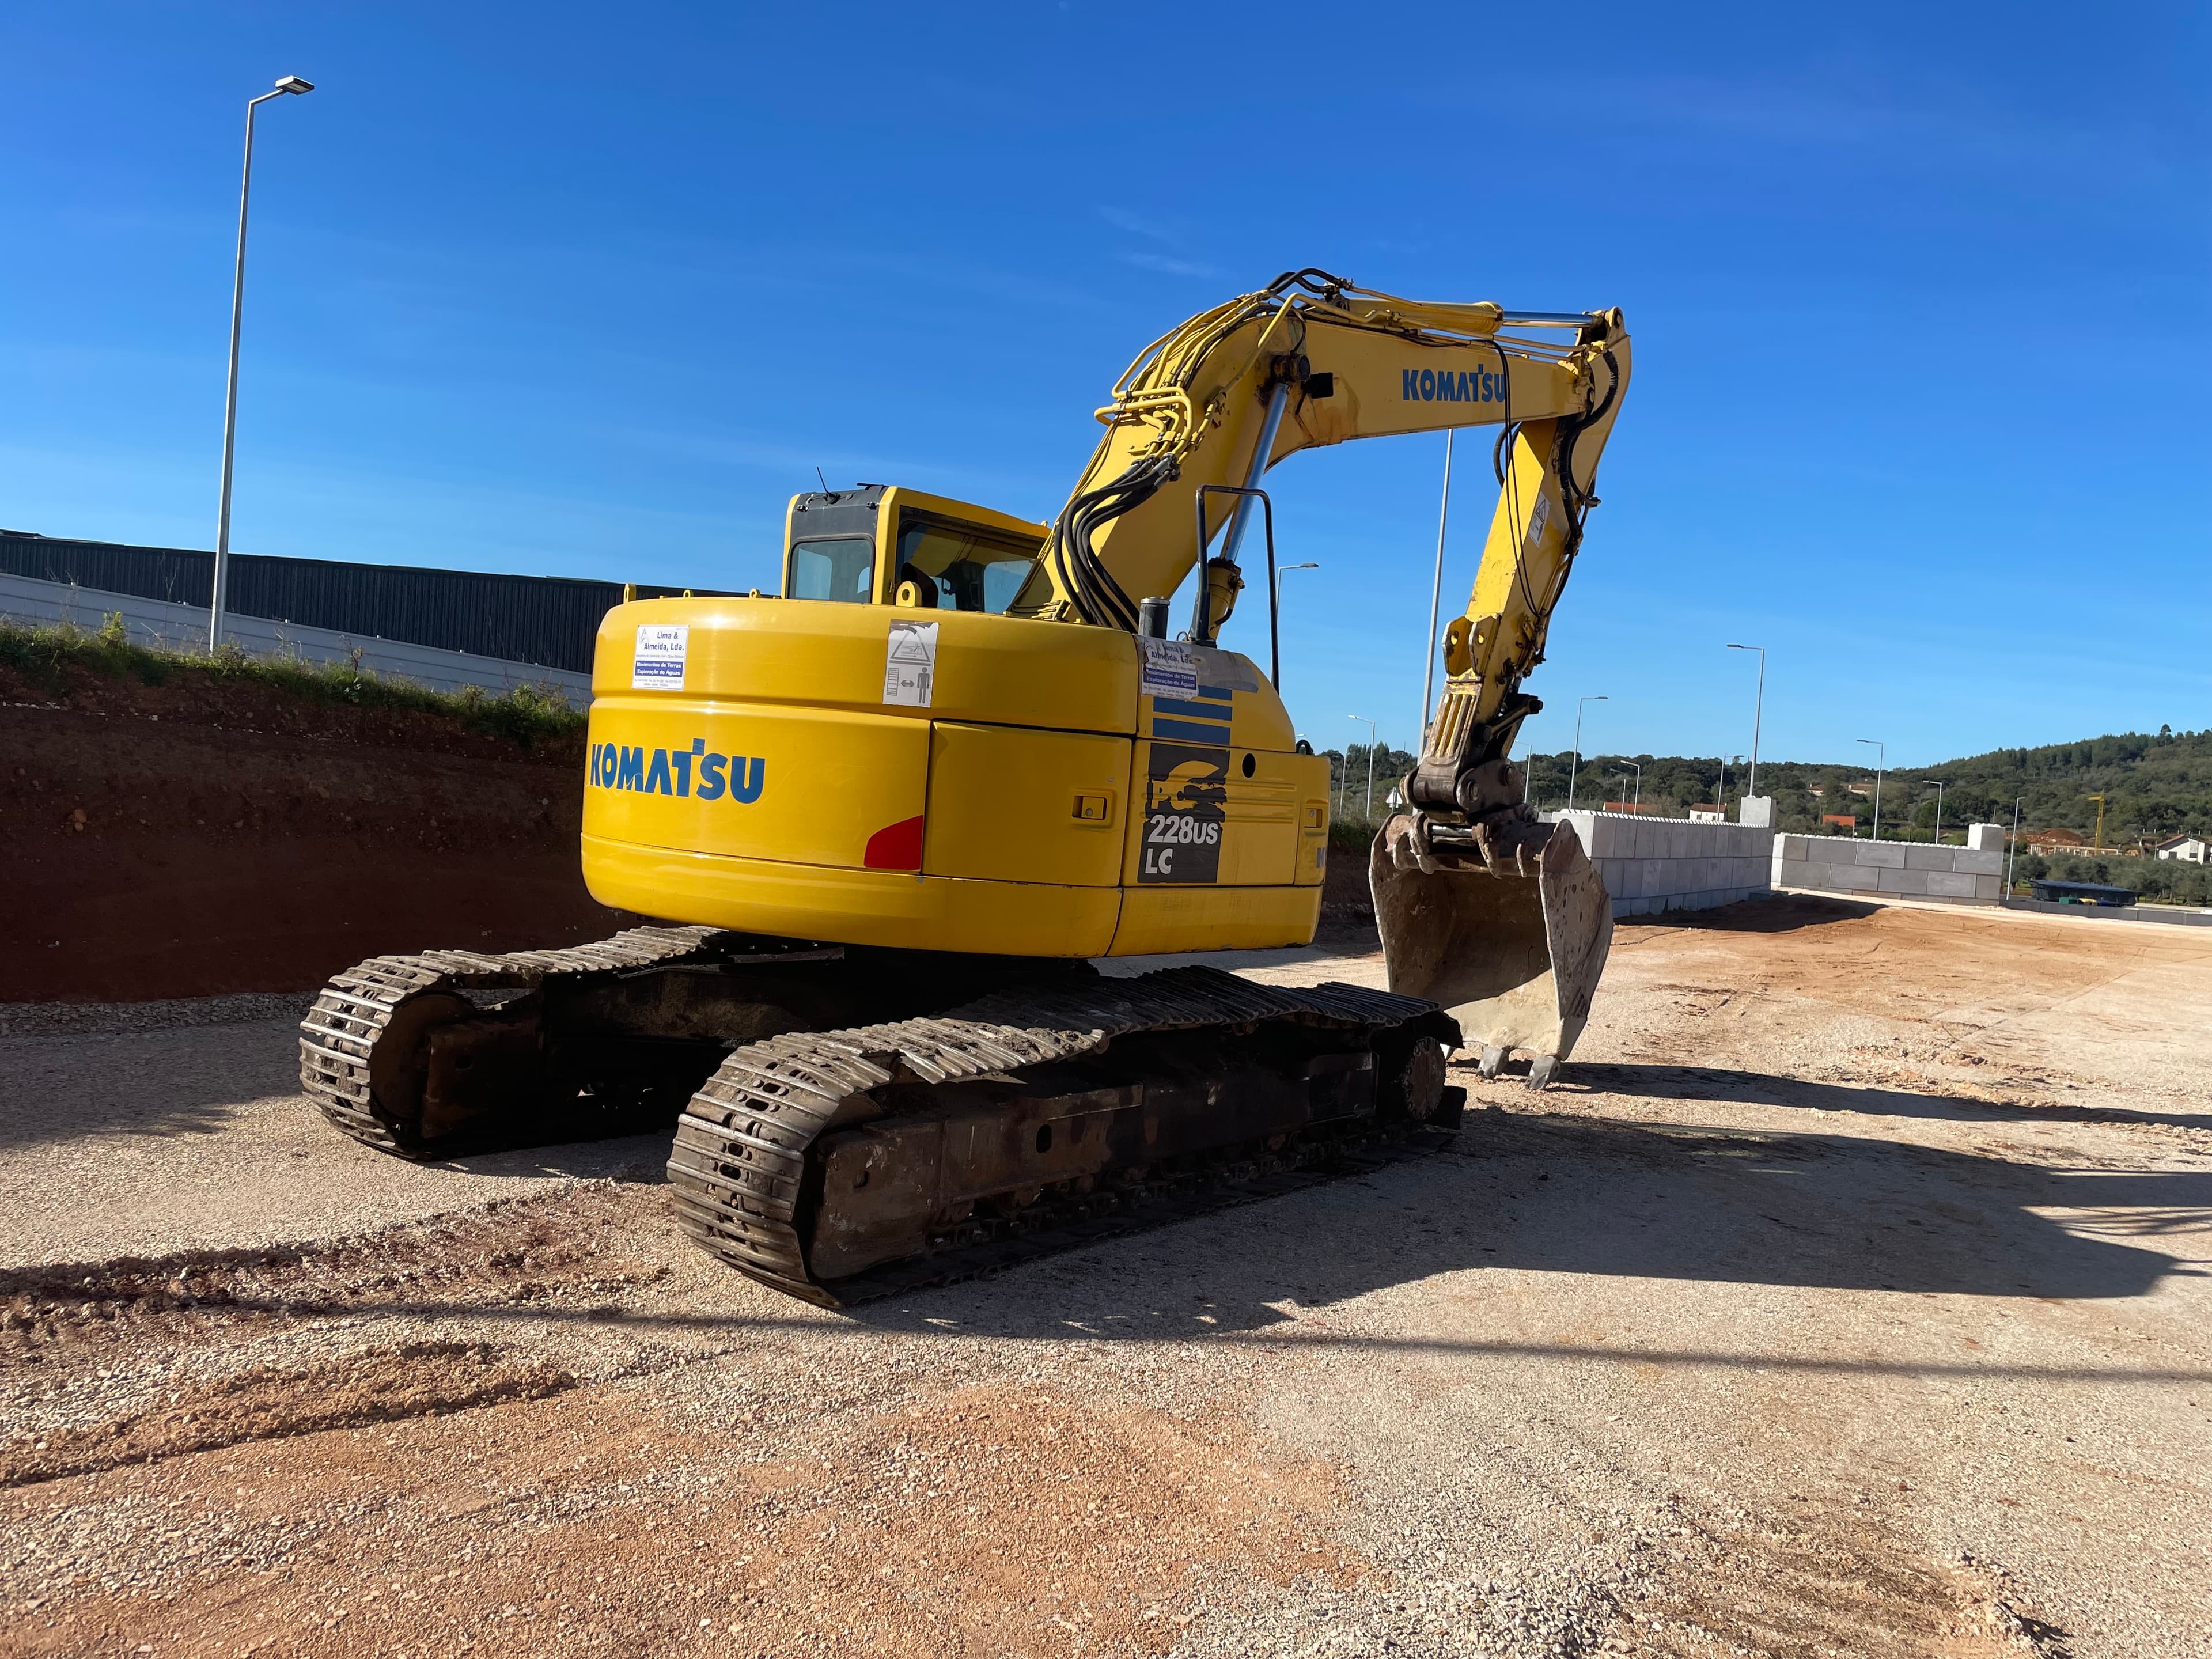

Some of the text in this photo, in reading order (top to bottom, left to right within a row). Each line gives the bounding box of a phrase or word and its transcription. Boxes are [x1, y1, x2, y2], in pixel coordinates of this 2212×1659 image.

[1403, 363, 1506, 402] KOMATSU
[644, 642, 684, 652] Almeida, Lda.
[673, 631, 679, 639] &
[590, 738, 765, 804] KOMATSU
[1147, 814, 1218, 844] 228US
[1145, 848, 1173, 874] LC
